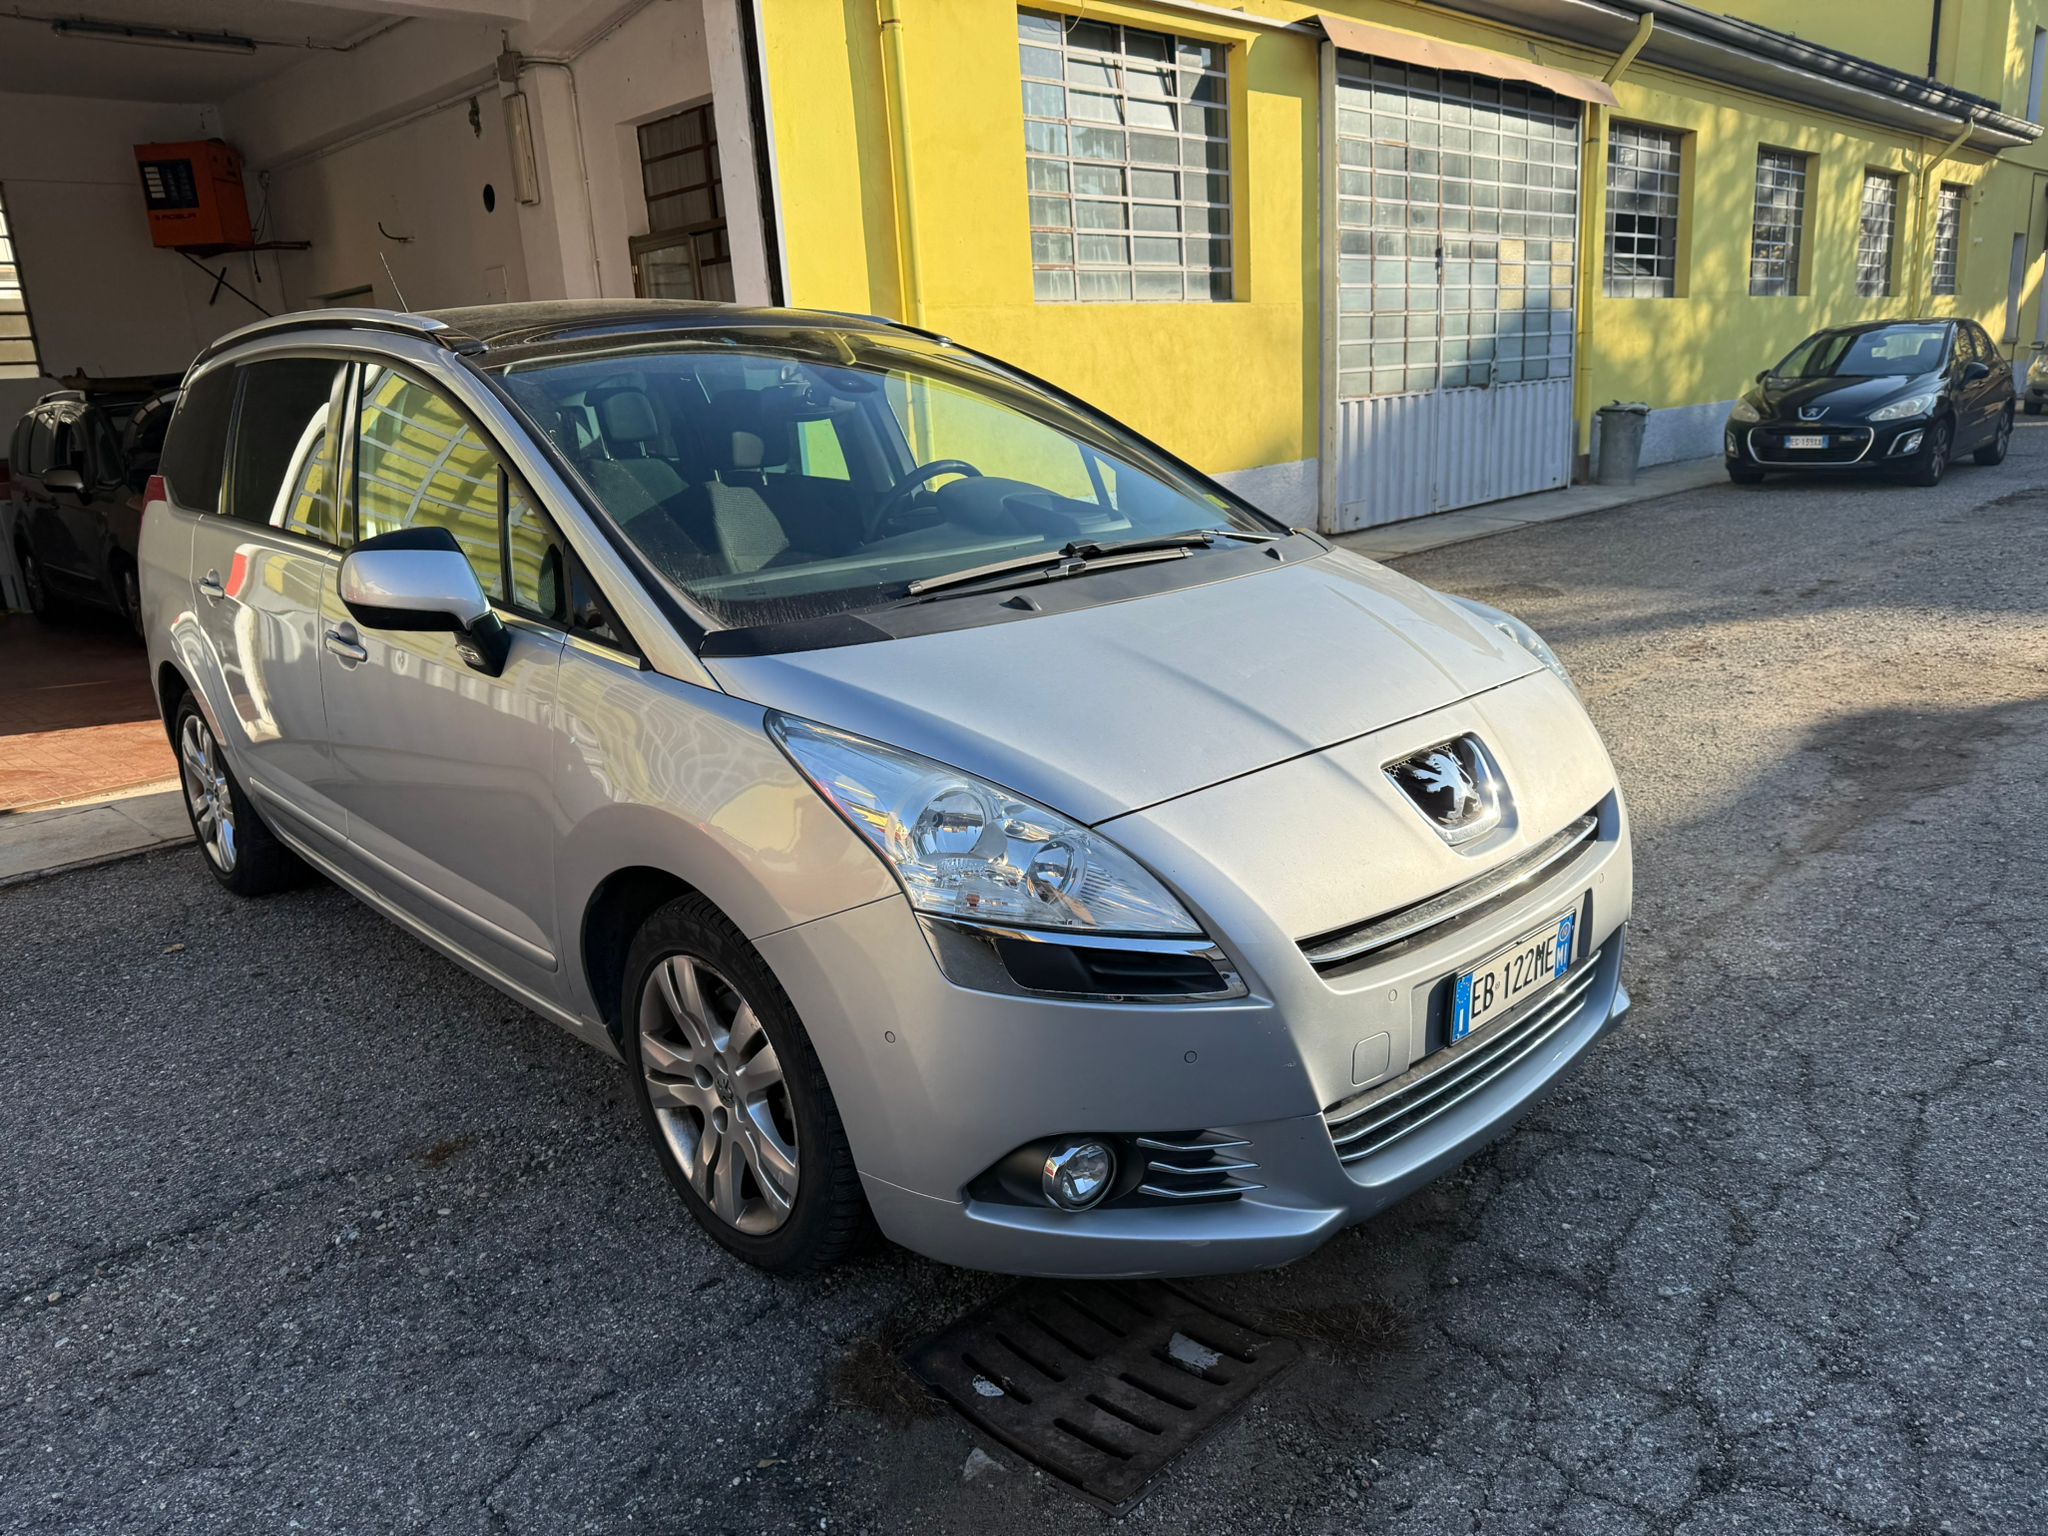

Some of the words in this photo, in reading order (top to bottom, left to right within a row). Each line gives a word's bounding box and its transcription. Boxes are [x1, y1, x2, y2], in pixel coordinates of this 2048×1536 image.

[1471, 972, 1495, 1019] EB
[1503, 934, 1557, 999] 122ME
[1556, 943, 1568, 968] MI
